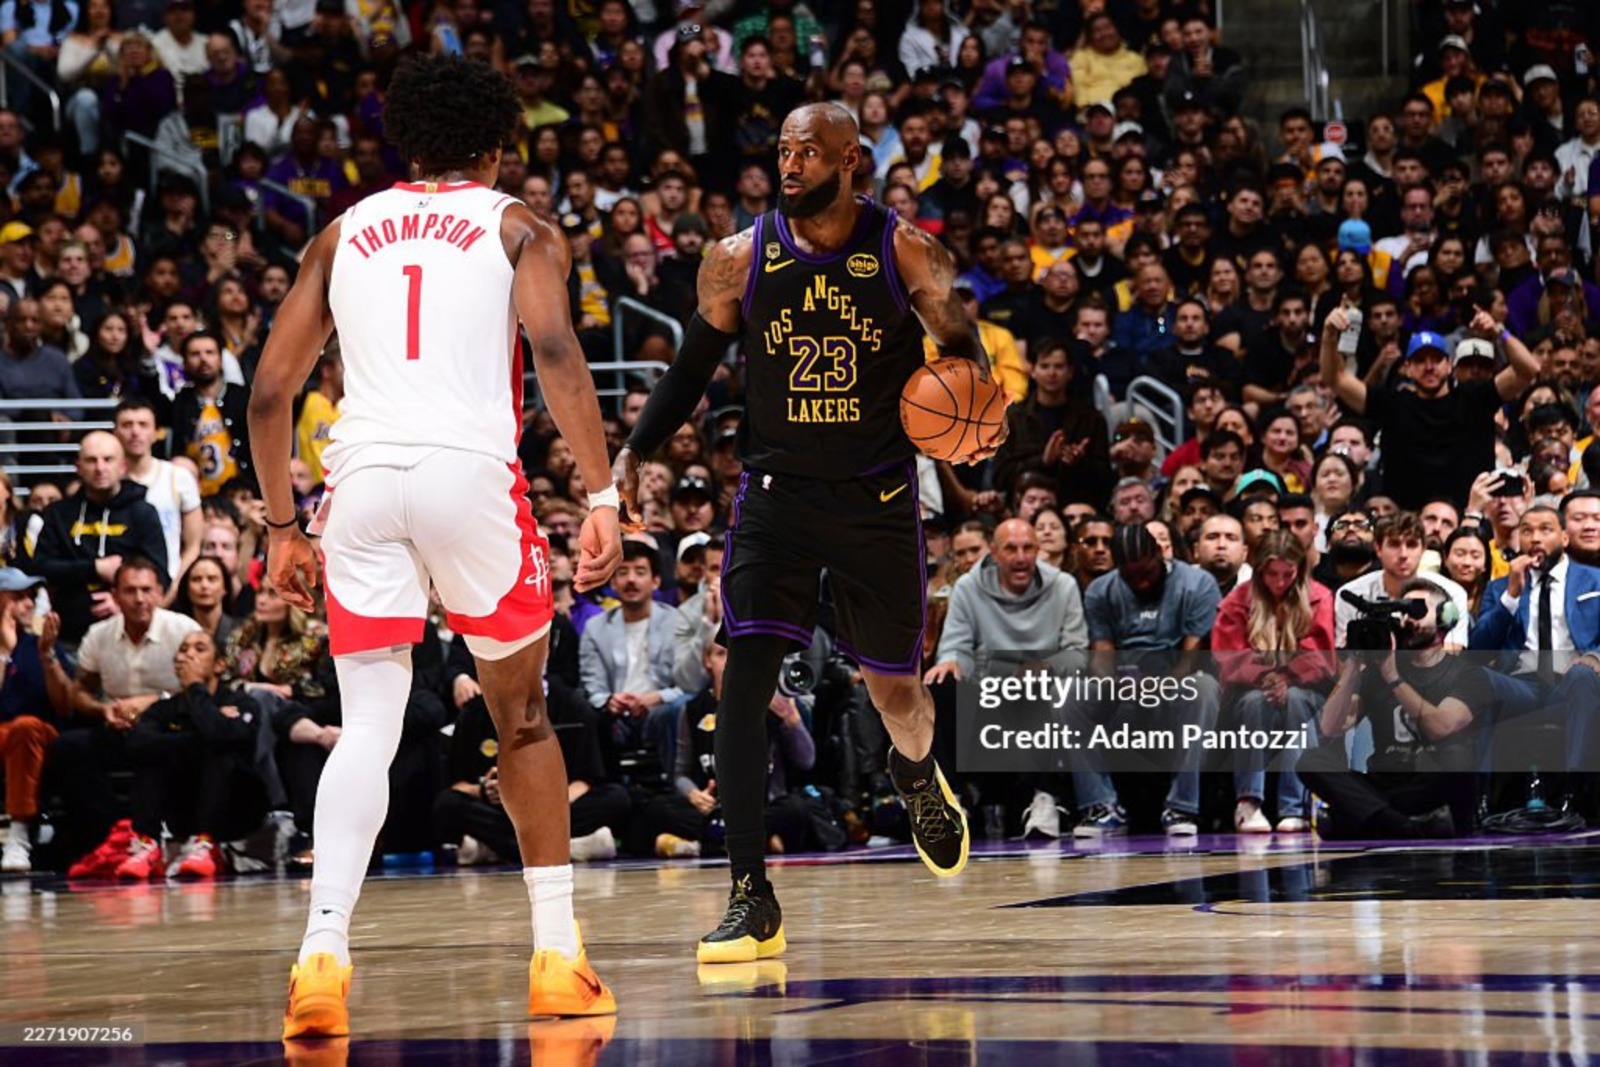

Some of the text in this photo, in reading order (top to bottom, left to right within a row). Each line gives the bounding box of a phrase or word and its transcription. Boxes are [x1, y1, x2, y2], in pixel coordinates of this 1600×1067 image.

[348, 213, 486, 259] THOMPSON
[402, 264, 423, 361] 1
[764, 274, 883, 356] LOS ANGELES
[788, 335, 858, 392] 23
[787, 397, 861, 423] LAKERS
